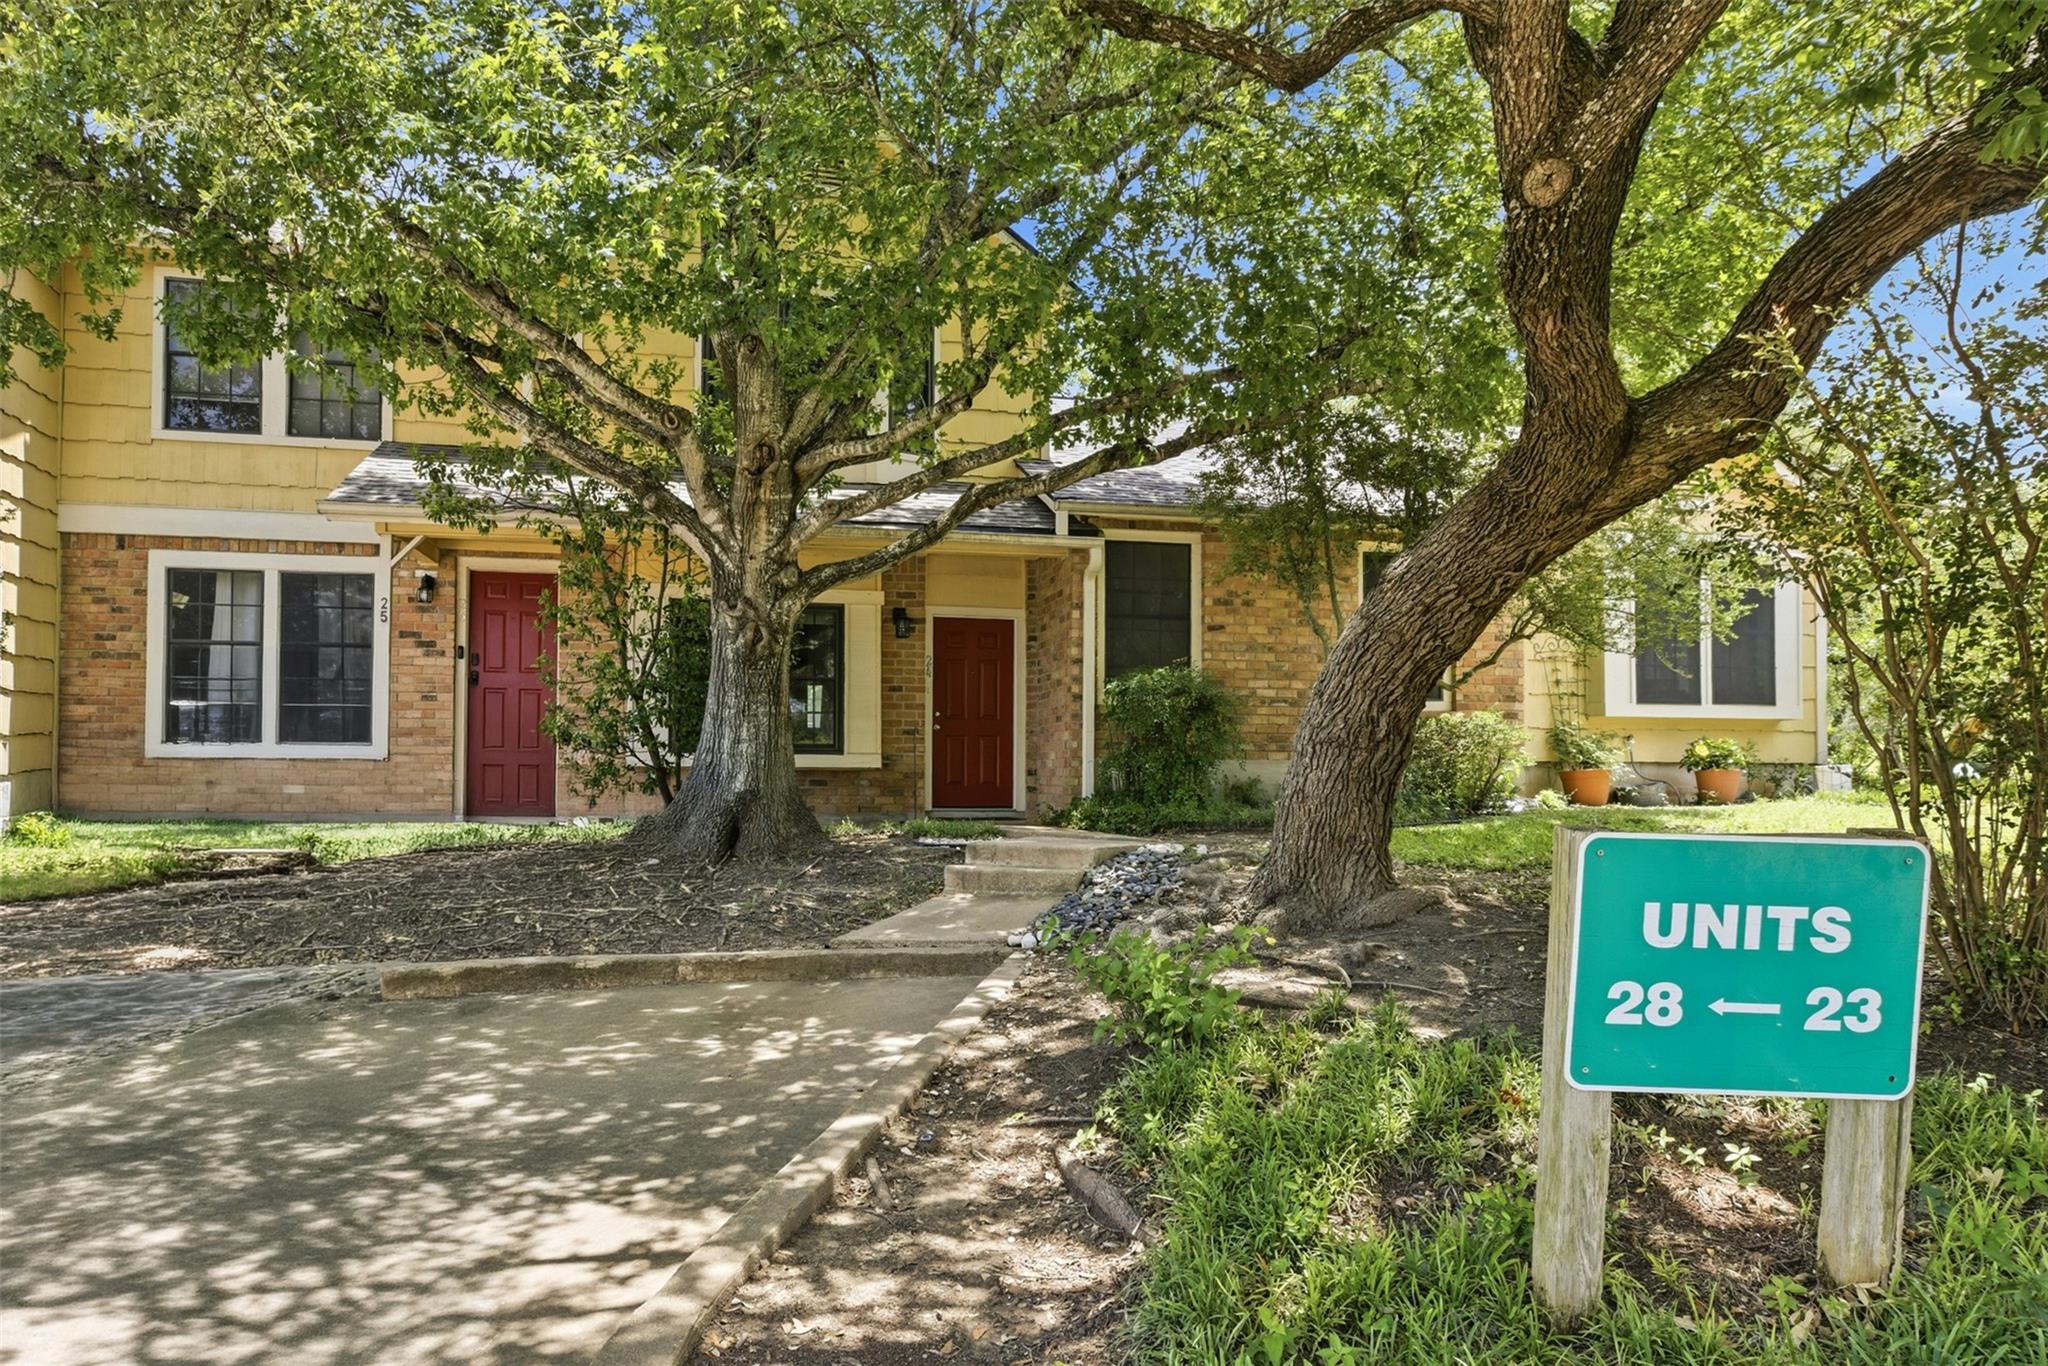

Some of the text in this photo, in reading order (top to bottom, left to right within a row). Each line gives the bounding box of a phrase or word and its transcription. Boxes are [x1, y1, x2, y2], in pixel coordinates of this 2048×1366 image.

[380, 597, 388, 623] 25
[1643, 902, 1851, 953] UNITS
[1605, 981, 1882, 1032] 28 23
